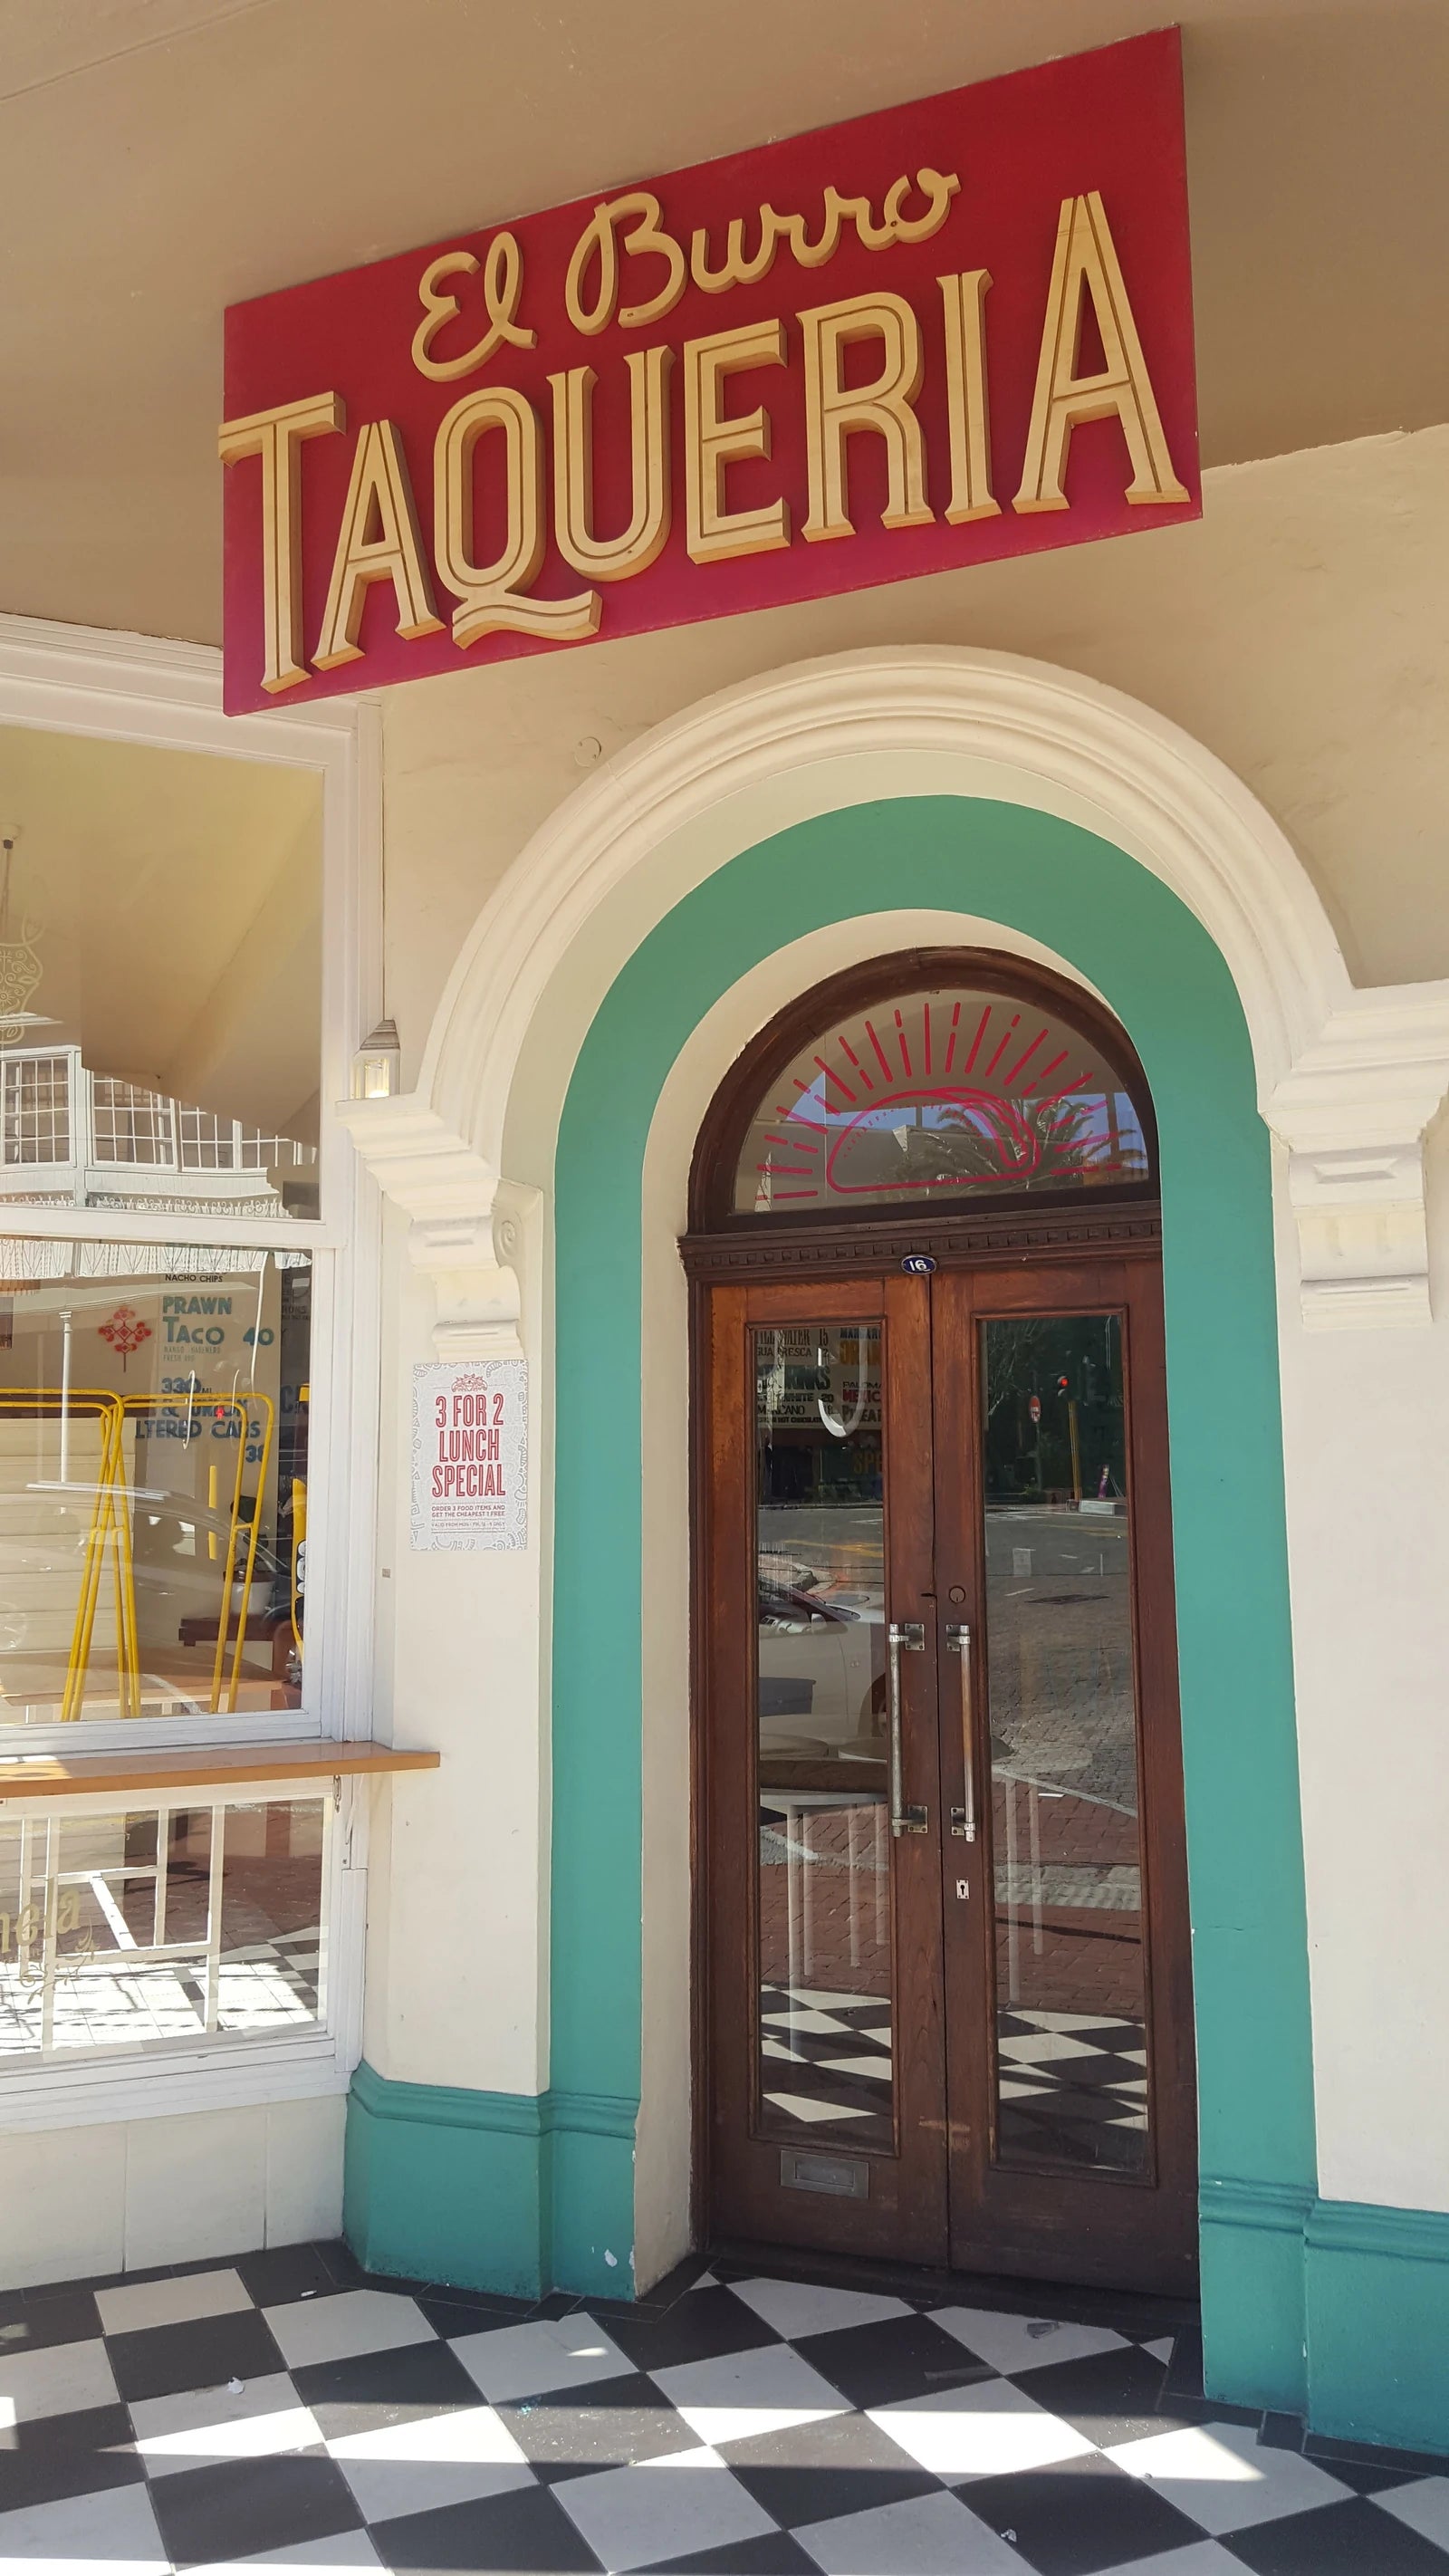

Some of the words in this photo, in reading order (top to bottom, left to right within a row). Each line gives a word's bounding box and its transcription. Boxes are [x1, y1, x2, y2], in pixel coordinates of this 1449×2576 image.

[411, 232, 538, 383] El
[564, 168, 960, 337] Burro
[218, 190, 1191, 696] TAQUERIA
[908, 1259, 931, 1272] 16
[162, 1296, 233, 1315] PRAWN
[162, 1316, 226, 1346] TACO
[243, 1326, 275, 1346] 40
[819, 1328, 829, 1346] 15
[435, 1396, 446, 1427] 3
[453, 1394, 487, 1427] FOR
[493, 1393, 504, 1425] 2
[439, 1429, 500, 1462] LUNCH
[431, 1464, 506, 1497] SPECIAL
